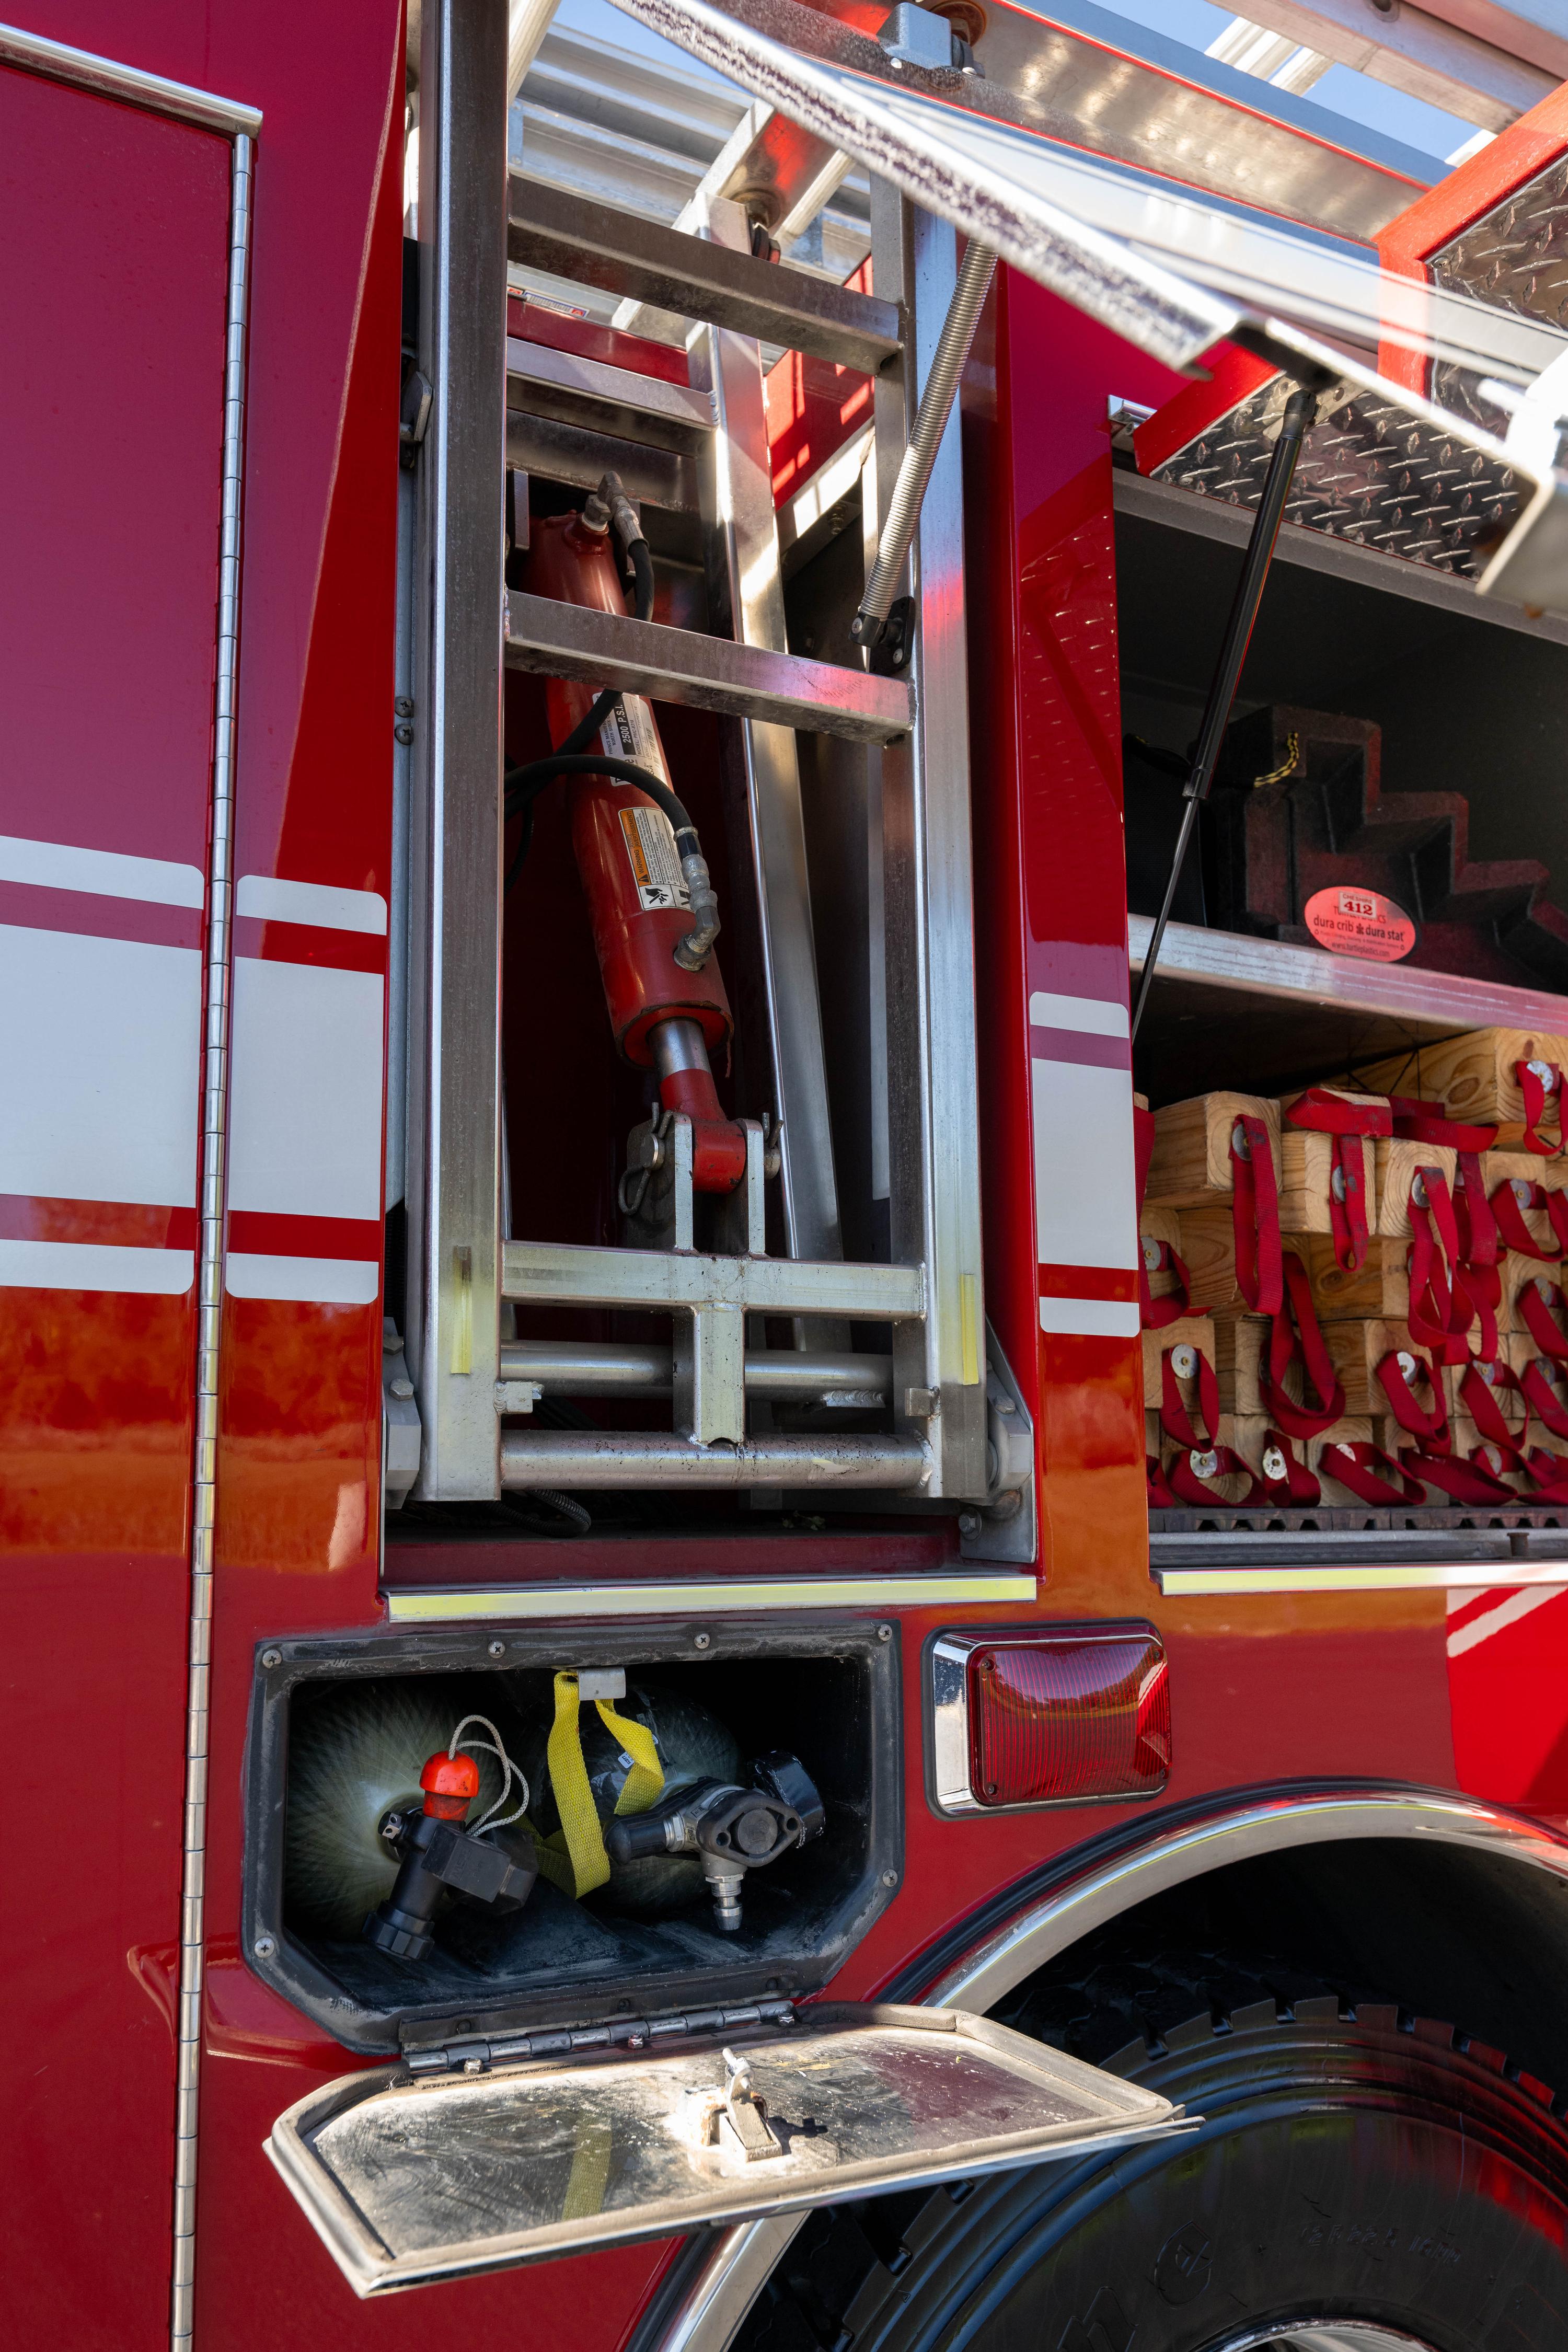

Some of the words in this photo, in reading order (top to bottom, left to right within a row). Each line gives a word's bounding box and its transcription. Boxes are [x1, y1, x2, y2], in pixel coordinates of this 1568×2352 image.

[615, 705, 627, 723] P.S.I.
[620, 726, 631, 743] 2500
[627, 811, 641, 847] (AVERTISSEMENT)
[634, 849, 644, 874] WARNING
[1343, 893, 1372, 904] CHESHIRE
[1344, 901, 1373, 915] 412
[1313, 915, 1334, 929] dura
[1337, 920, 1353, 932] crib
[1366, 926, 1385, 938] dura
[1388, 930, 1403, 941] stat
[622, 1756, 631, 1765] SCOTT
